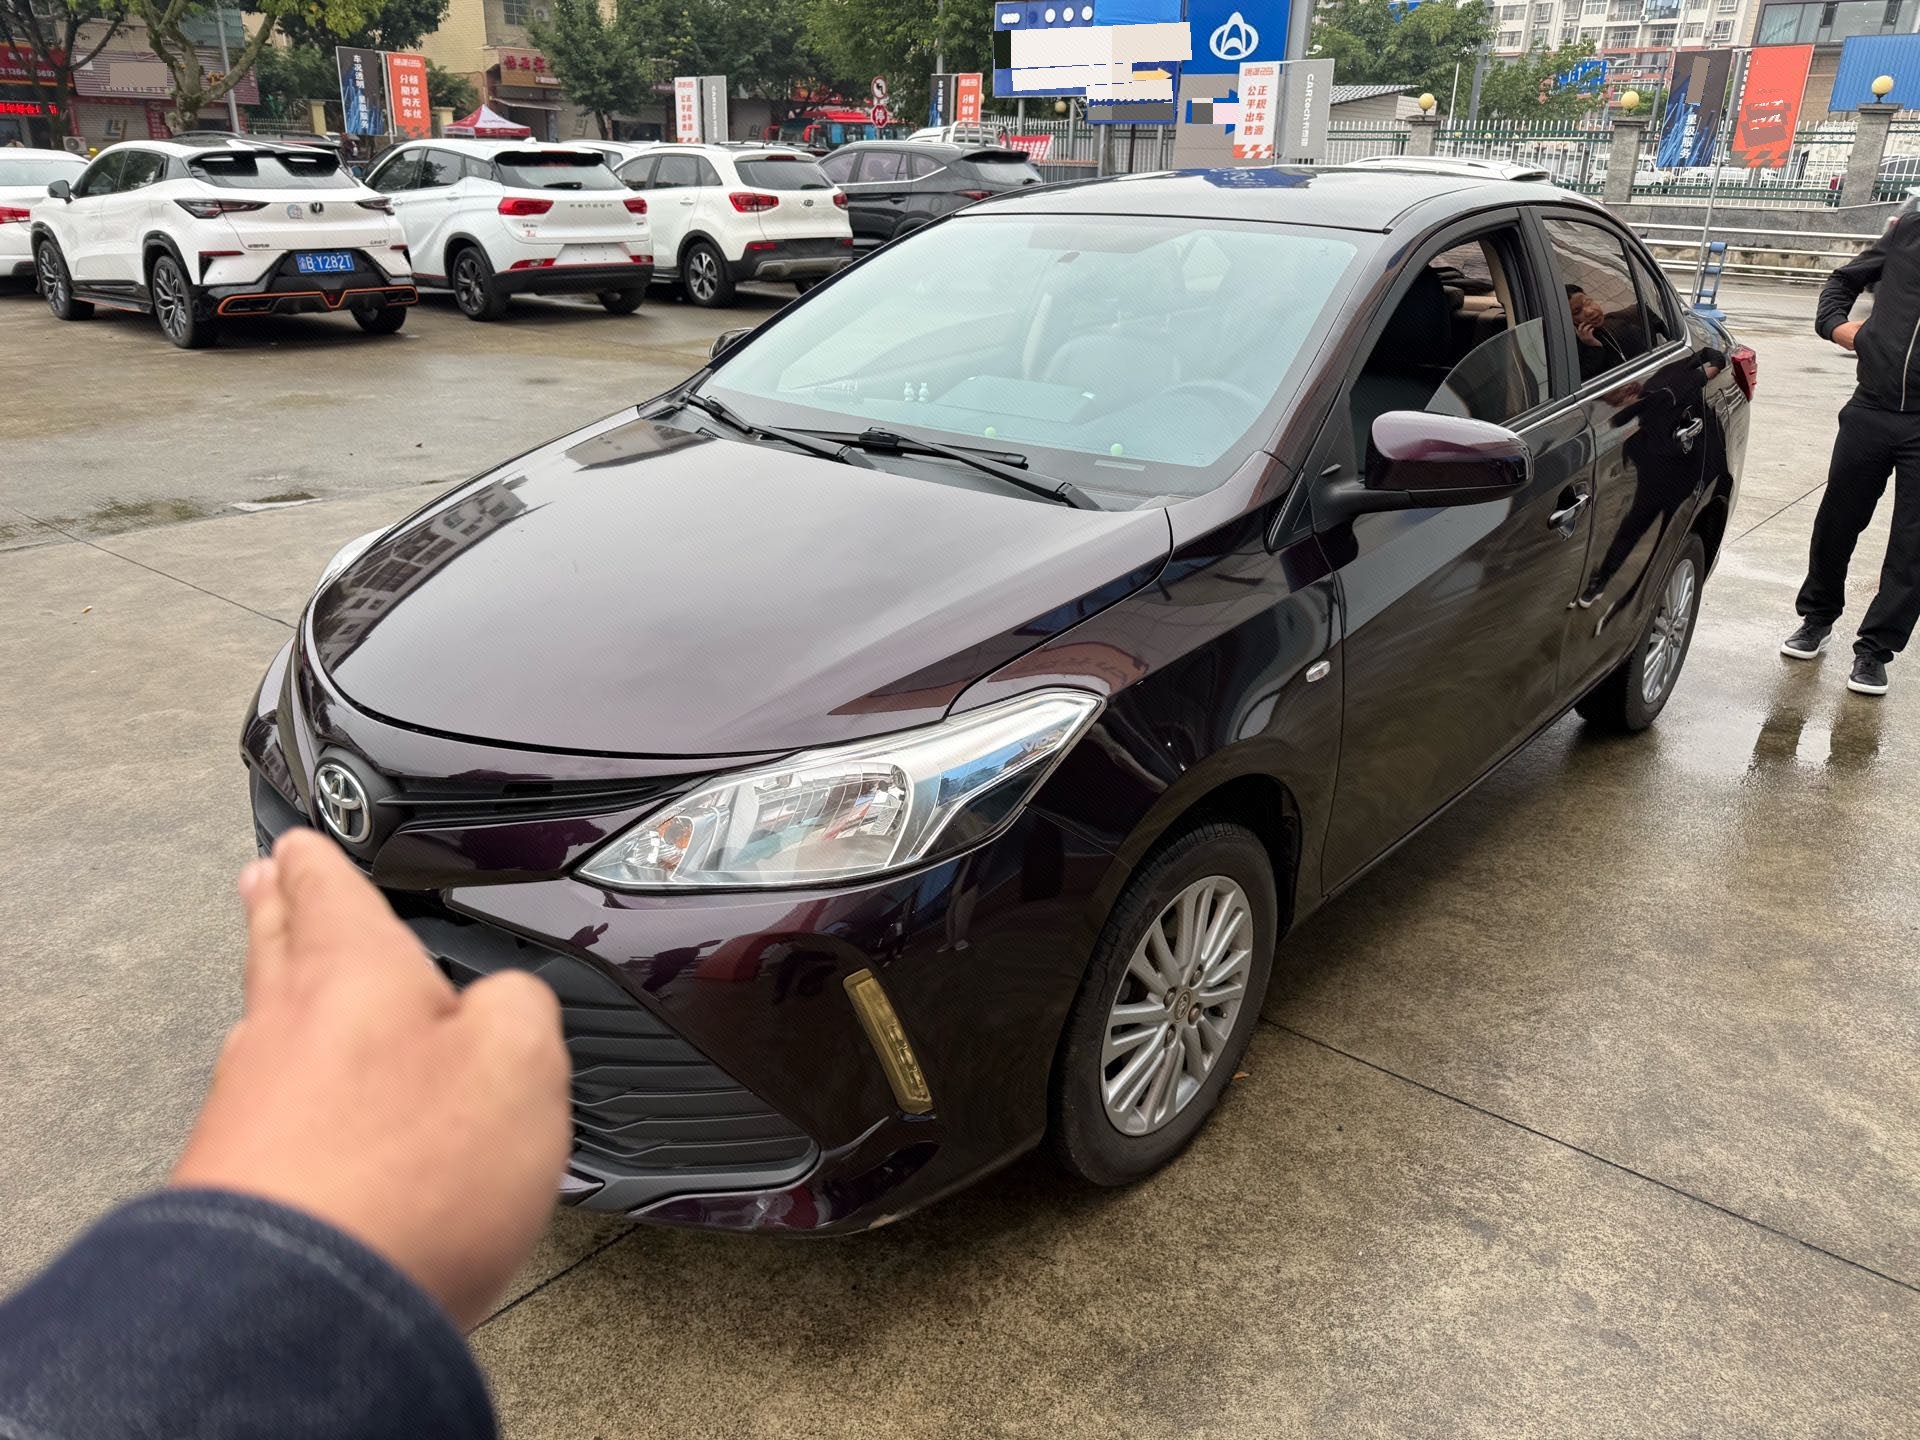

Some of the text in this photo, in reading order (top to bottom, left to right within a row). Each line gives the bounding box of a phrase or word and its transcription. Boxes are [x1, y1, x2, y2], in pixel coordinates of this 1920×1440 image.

[1244, 85, 1256, 135] 公平出售
[1254, 85, 1268, 135] 正规车源
[1680, 114, 1697, 159] 星级服务
